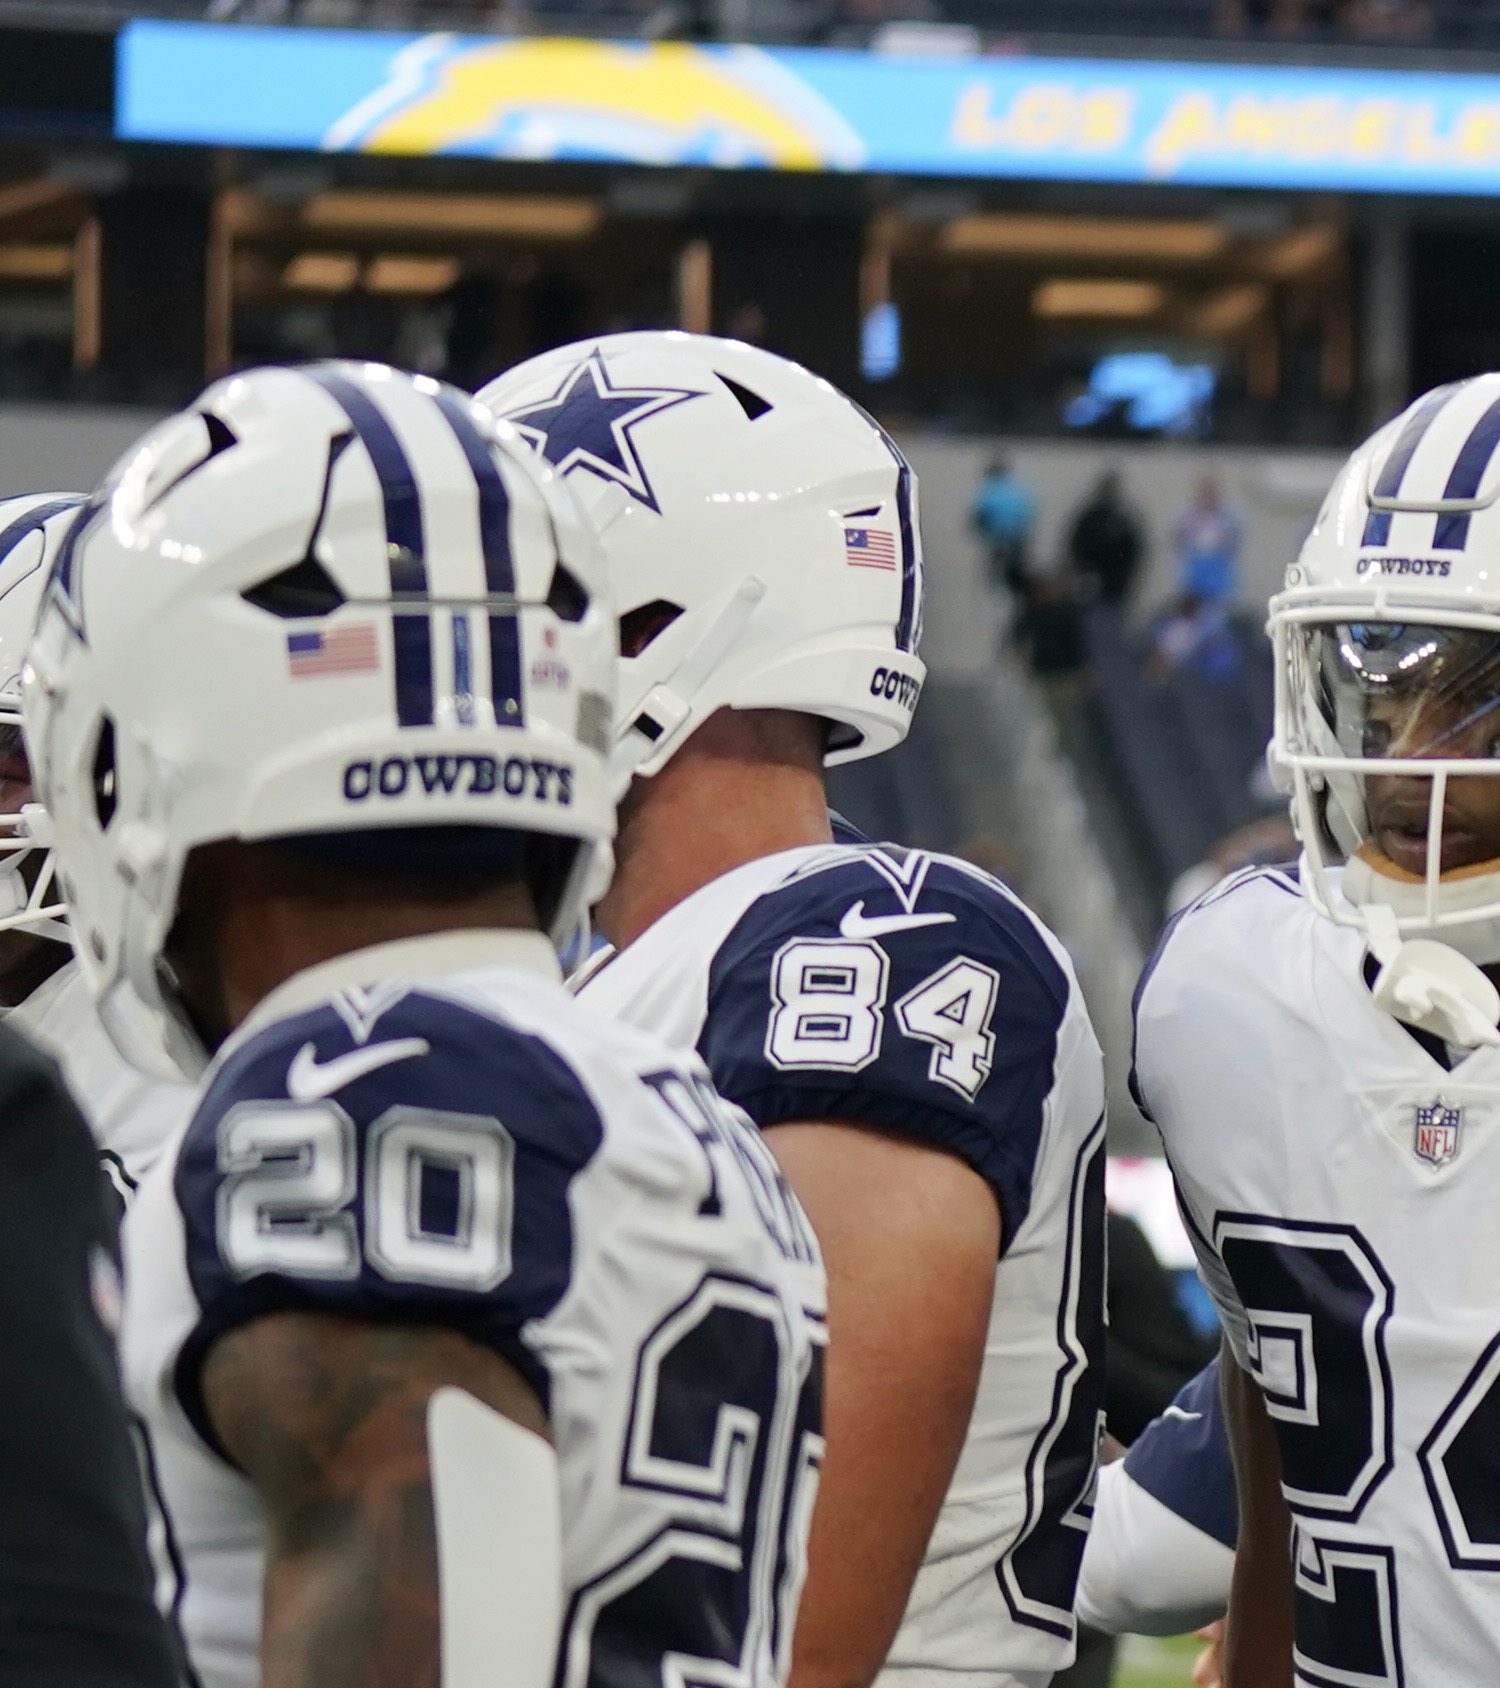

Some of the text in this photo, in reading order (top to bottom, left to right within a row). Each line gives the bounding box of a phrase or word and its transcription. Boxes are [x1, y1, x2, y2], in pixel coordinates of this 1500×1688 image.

[950, 82, 1136, 152] LOS
[342, 752, 575, 806] COWBOYS
[764, 936, 1001, 1104] 84
[1421, 1128, 1452, 1156] NFL
[215, 1098, 516, 1295] 20
